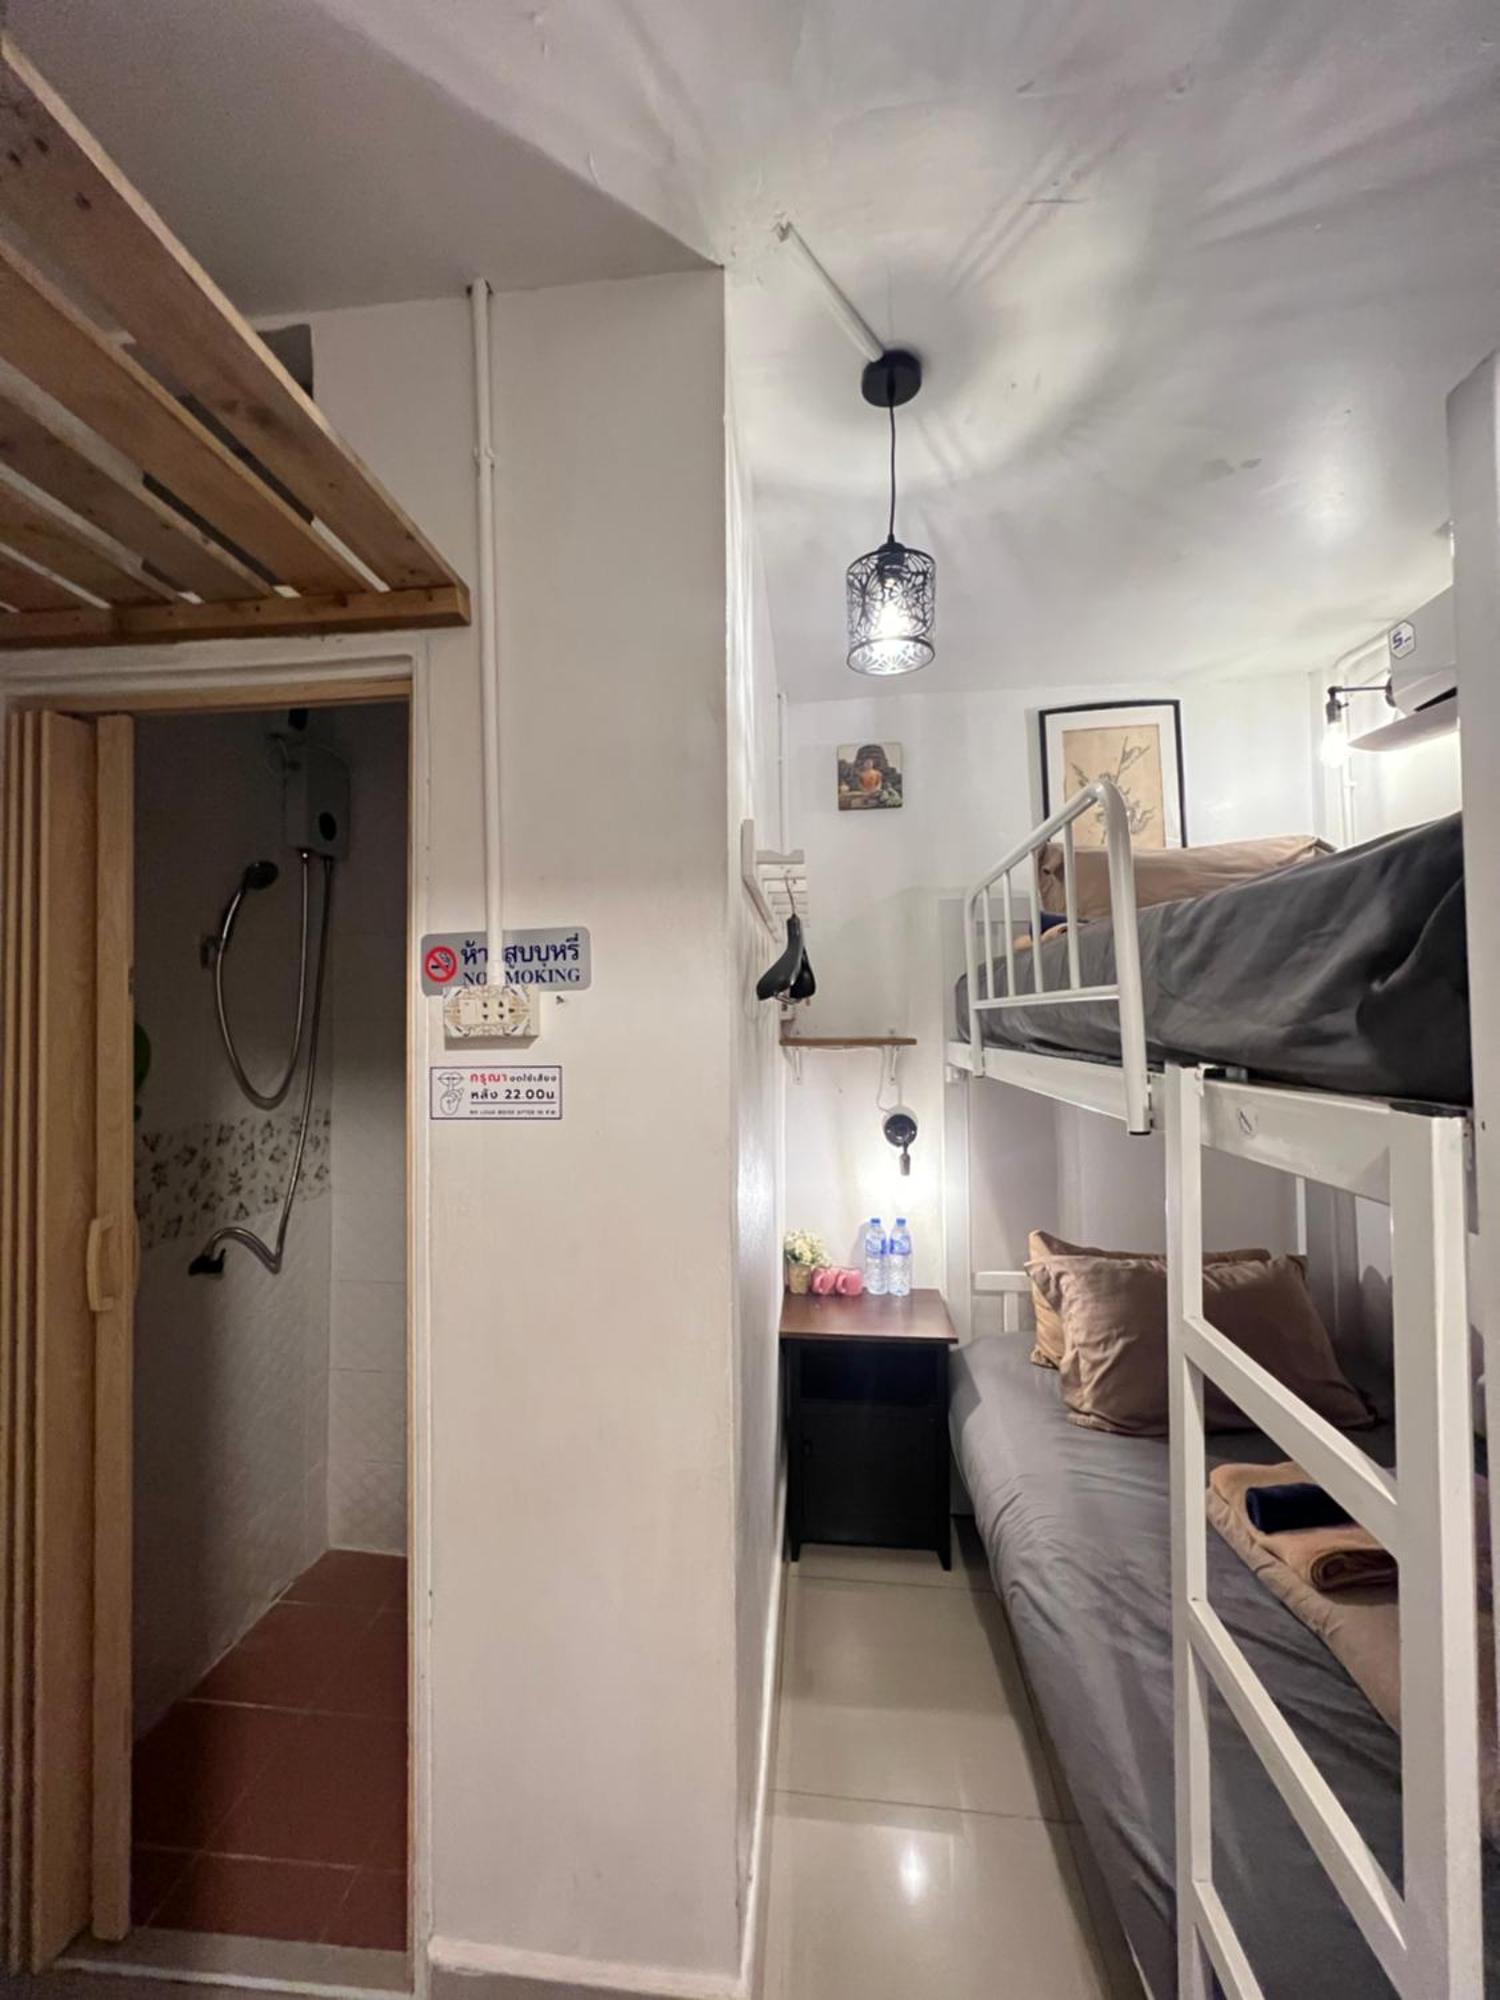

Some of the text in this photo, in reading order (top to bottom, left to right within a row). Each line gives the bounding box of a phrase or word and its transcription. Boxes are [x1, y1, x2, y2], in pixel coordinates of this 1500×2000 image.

[461, 933, 580, 969] ห้าสูบบุหรี่
[504, 968, 580, 985] MOKING
[470, 1073, 507, 1085] กรุณา
